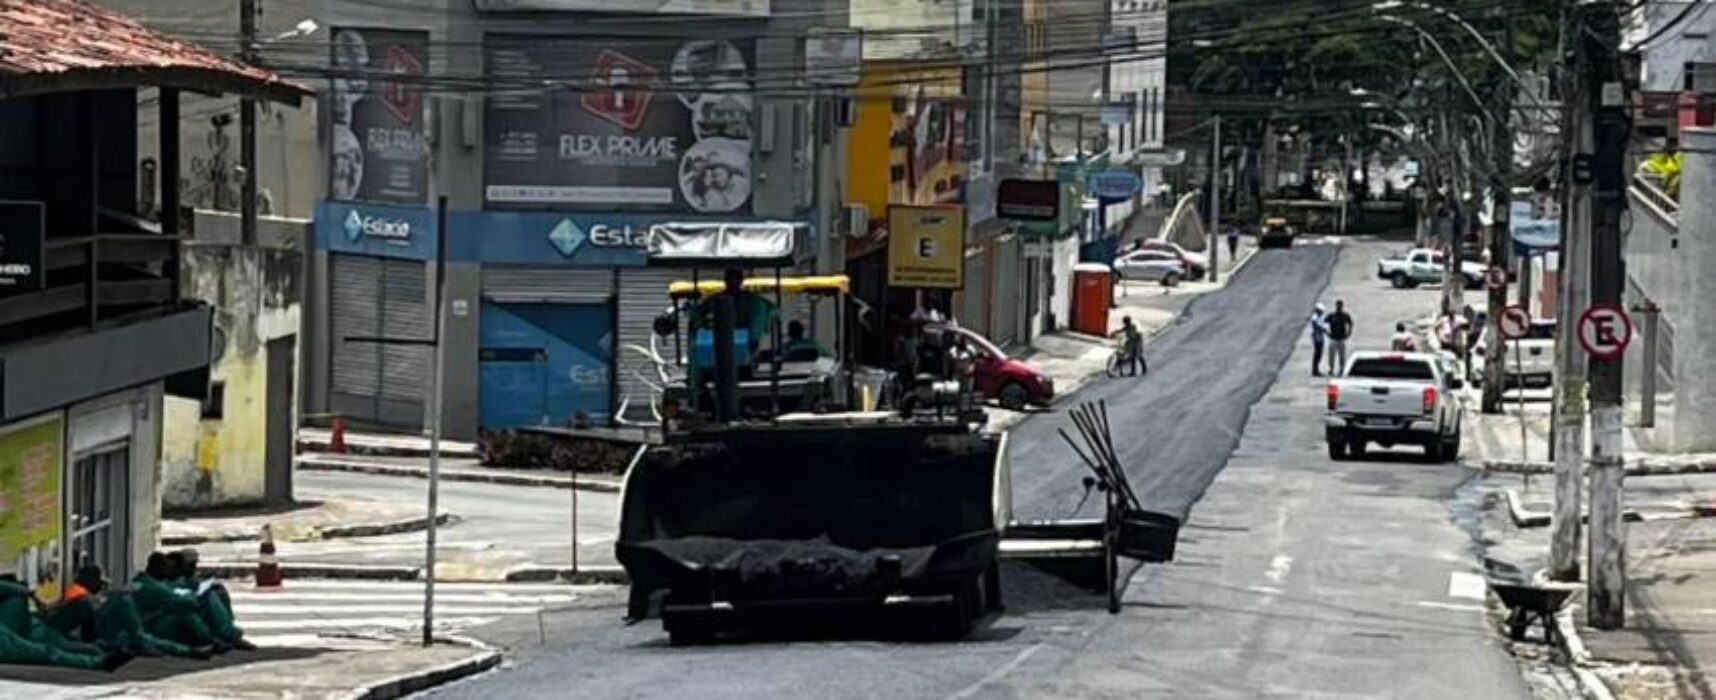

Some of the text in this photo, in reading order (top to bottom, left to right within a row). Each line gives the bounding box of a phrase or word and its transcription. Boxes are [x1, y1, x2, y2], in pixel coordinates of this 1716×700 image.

[560, 135, 601, 159] FLEX
[607, 135, 678, 160] PRIME
[589, 224, 649, 247] Esta
[1595, 315, 1615, 346] E
